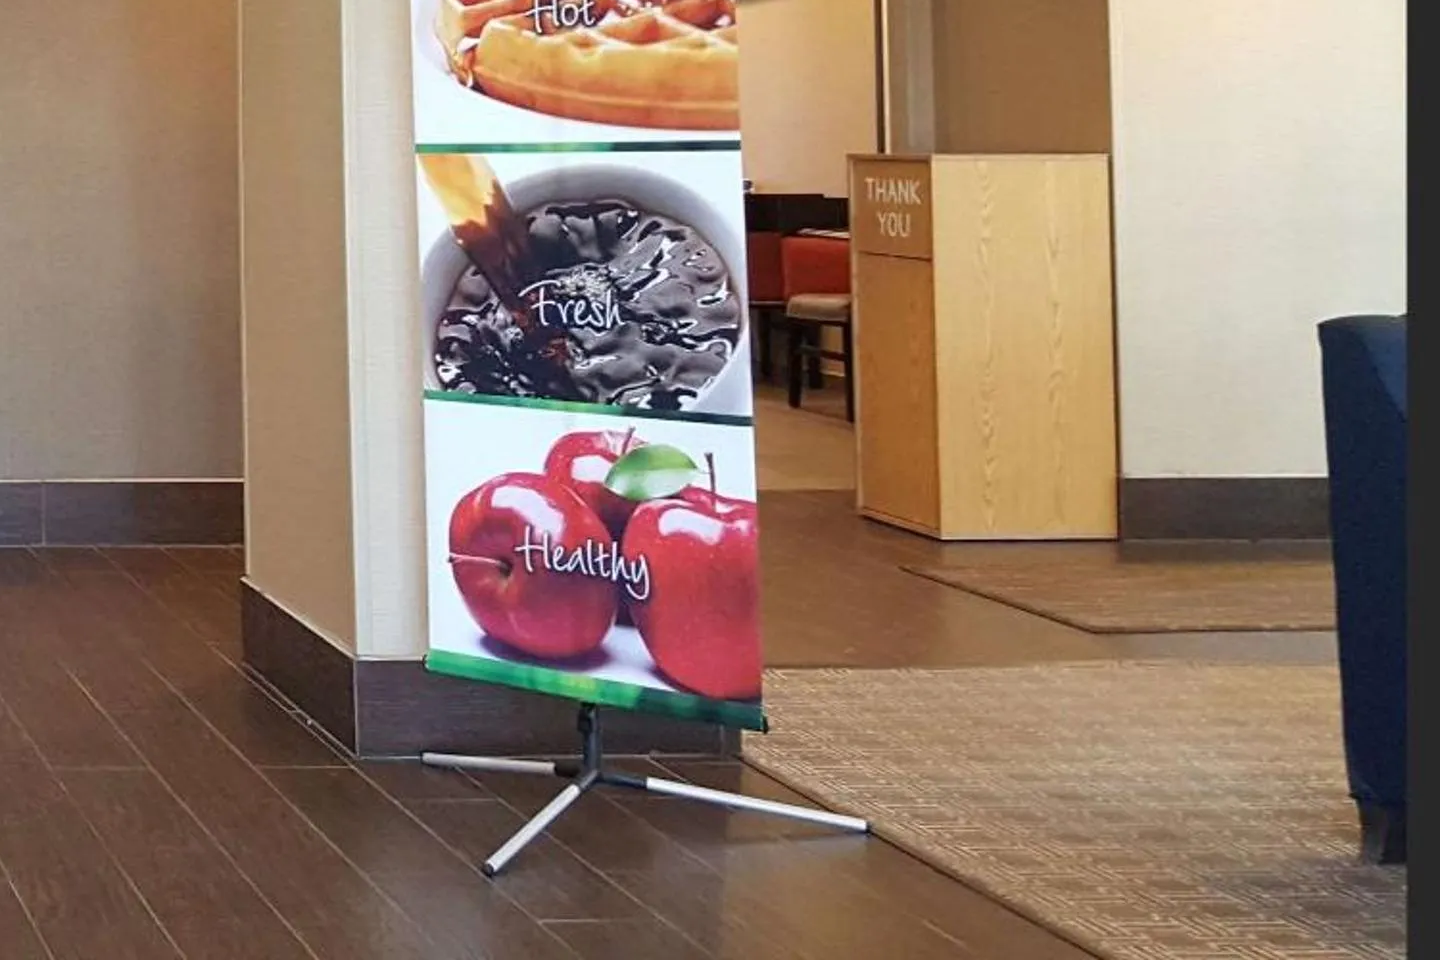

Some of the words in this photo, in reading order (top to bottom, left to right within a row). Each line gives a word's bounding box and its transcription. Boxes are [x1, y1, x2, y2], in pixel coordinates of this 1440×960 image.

[864, 177, 922, 205] THANK
[876, 211, 911, 237] YOU
[518, 279, 625, 328] Fresh
[515, 526, 650, 600] Healthy
